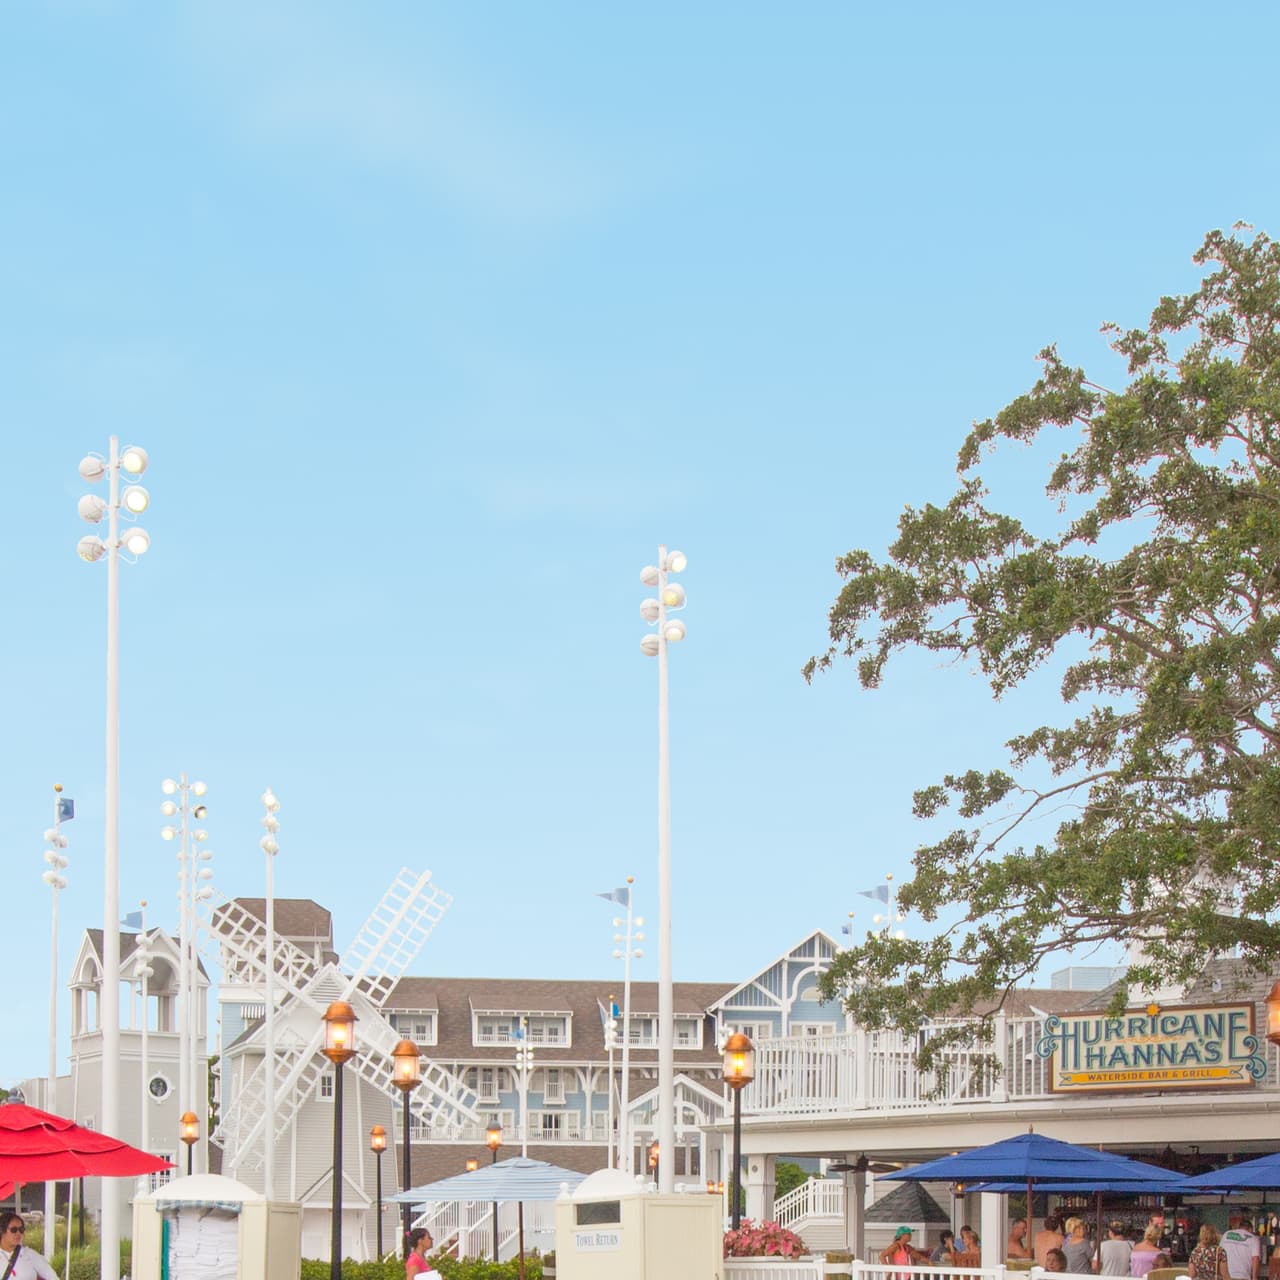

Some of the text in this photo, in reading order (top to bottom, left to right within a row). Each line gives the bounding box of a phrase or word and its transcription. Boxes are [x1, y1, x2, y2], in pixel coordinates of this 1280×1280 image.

[1037, 1012, 1267, 1080] HURRICANE
[1085, 1039, 1223, 1069] HANNA'S
[1087, 1068, 1212, 1081] WATERSIDE BAR & GRILL
[576, 1232, 618, 1248] TOWEL RETURN
